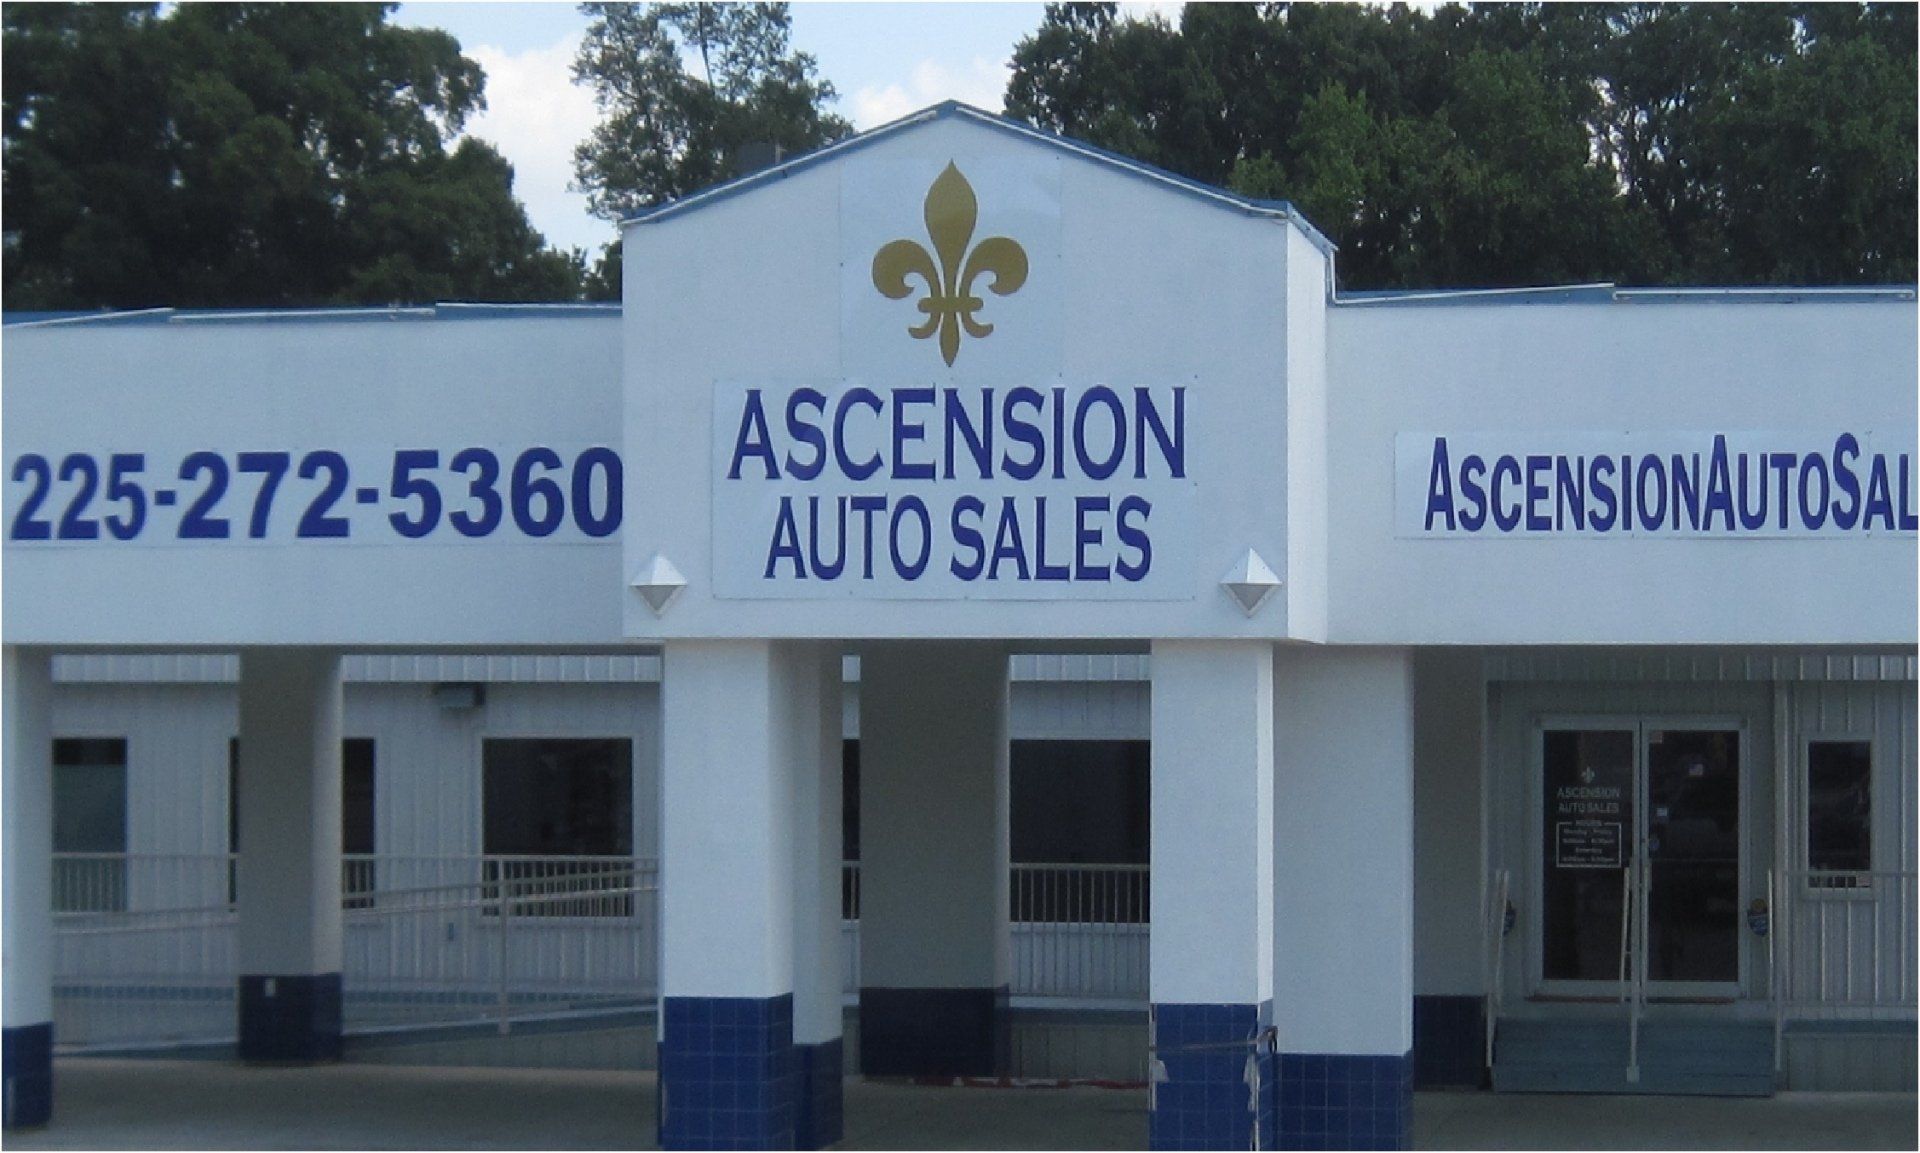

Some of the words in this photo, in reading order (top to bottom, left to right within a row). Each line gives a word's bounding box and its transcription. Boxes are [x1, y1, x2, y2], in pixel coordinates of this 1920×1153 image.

[728, 384, 1187, 482] ASCENSION
[10, 446, 623, 541] 225-272-5360
[764, 494, 932, 581] AUTO
[950, 494, 1153, 583] SALES
[1556, 786, 1620, 799] ASCENSION
